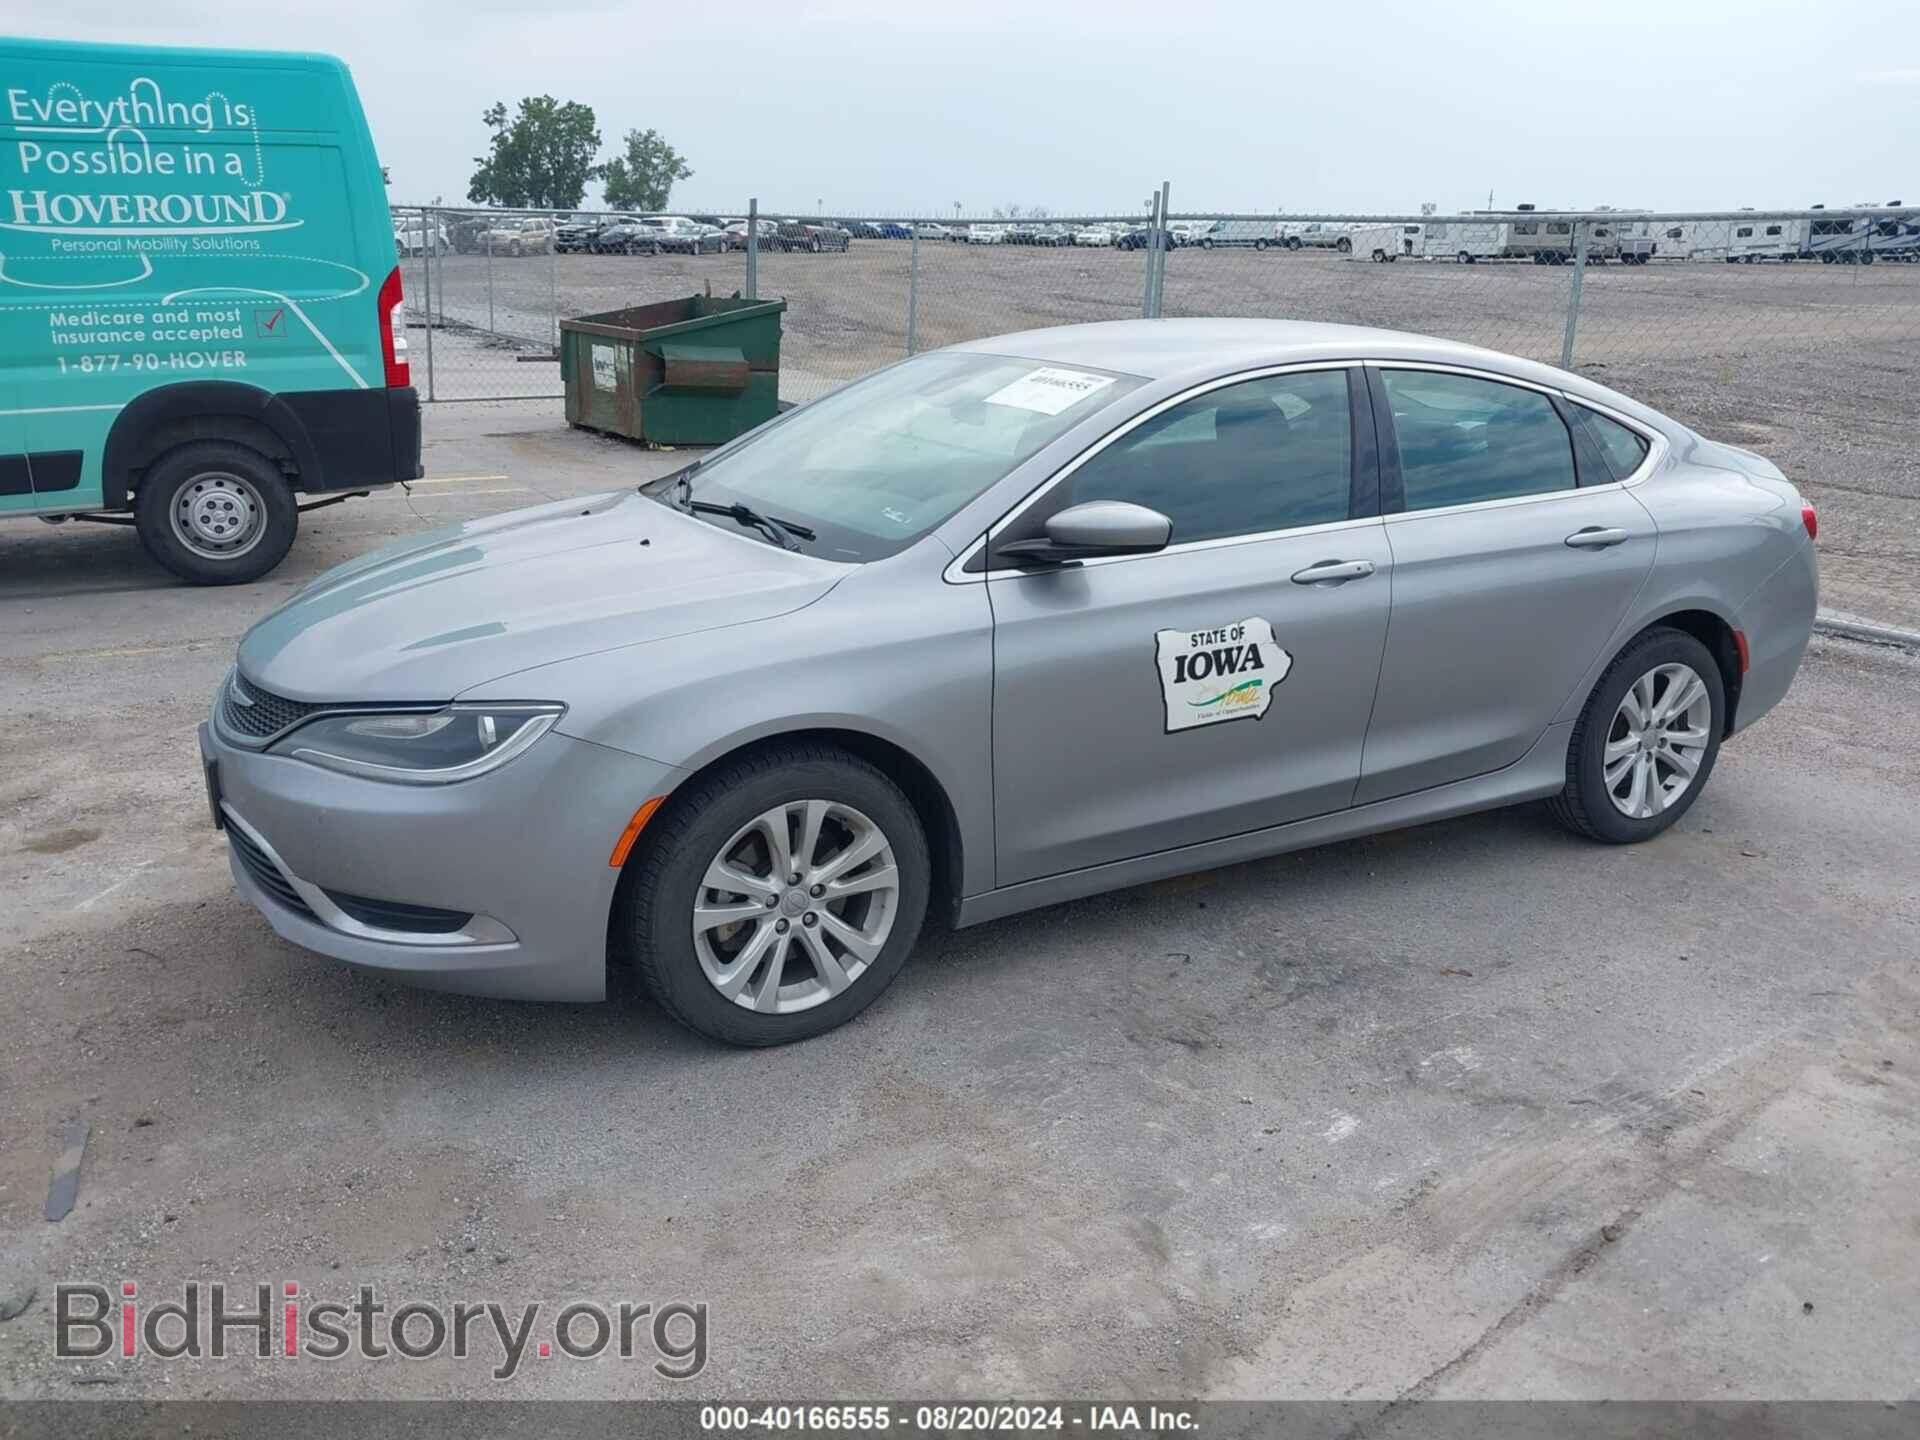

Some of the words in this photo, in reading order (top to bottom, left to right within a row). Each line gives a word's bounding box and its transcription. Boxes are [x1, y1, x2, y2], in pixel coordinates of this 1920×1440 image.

[224, 104, 250, 126] is
[19, 141, 175, 175] Possible
[183, 146, 215, 175] in
[224, 152, 242, 176] a
[8, 189, 286, 224] HOVEROUND
[52, 238, 121, 252] Personal
[127, 238, 187, 252] Mobility
[192, 238, 260, 251] Solutions
[50, 311, 145, 327] Medicare
[152, 309, 189, 324] and
[196, 308, 241, 323] most
[52, 330, 145, 345] insurance
[152, 325, 244, 343] accepted
[57, 350, 247, 374] 1-877-90-HOVER
[1191, 629, 1226, 647] STATE
[1230, 626, 1245, 641] OF
[1174, 643, 1264, 683] IOWA
